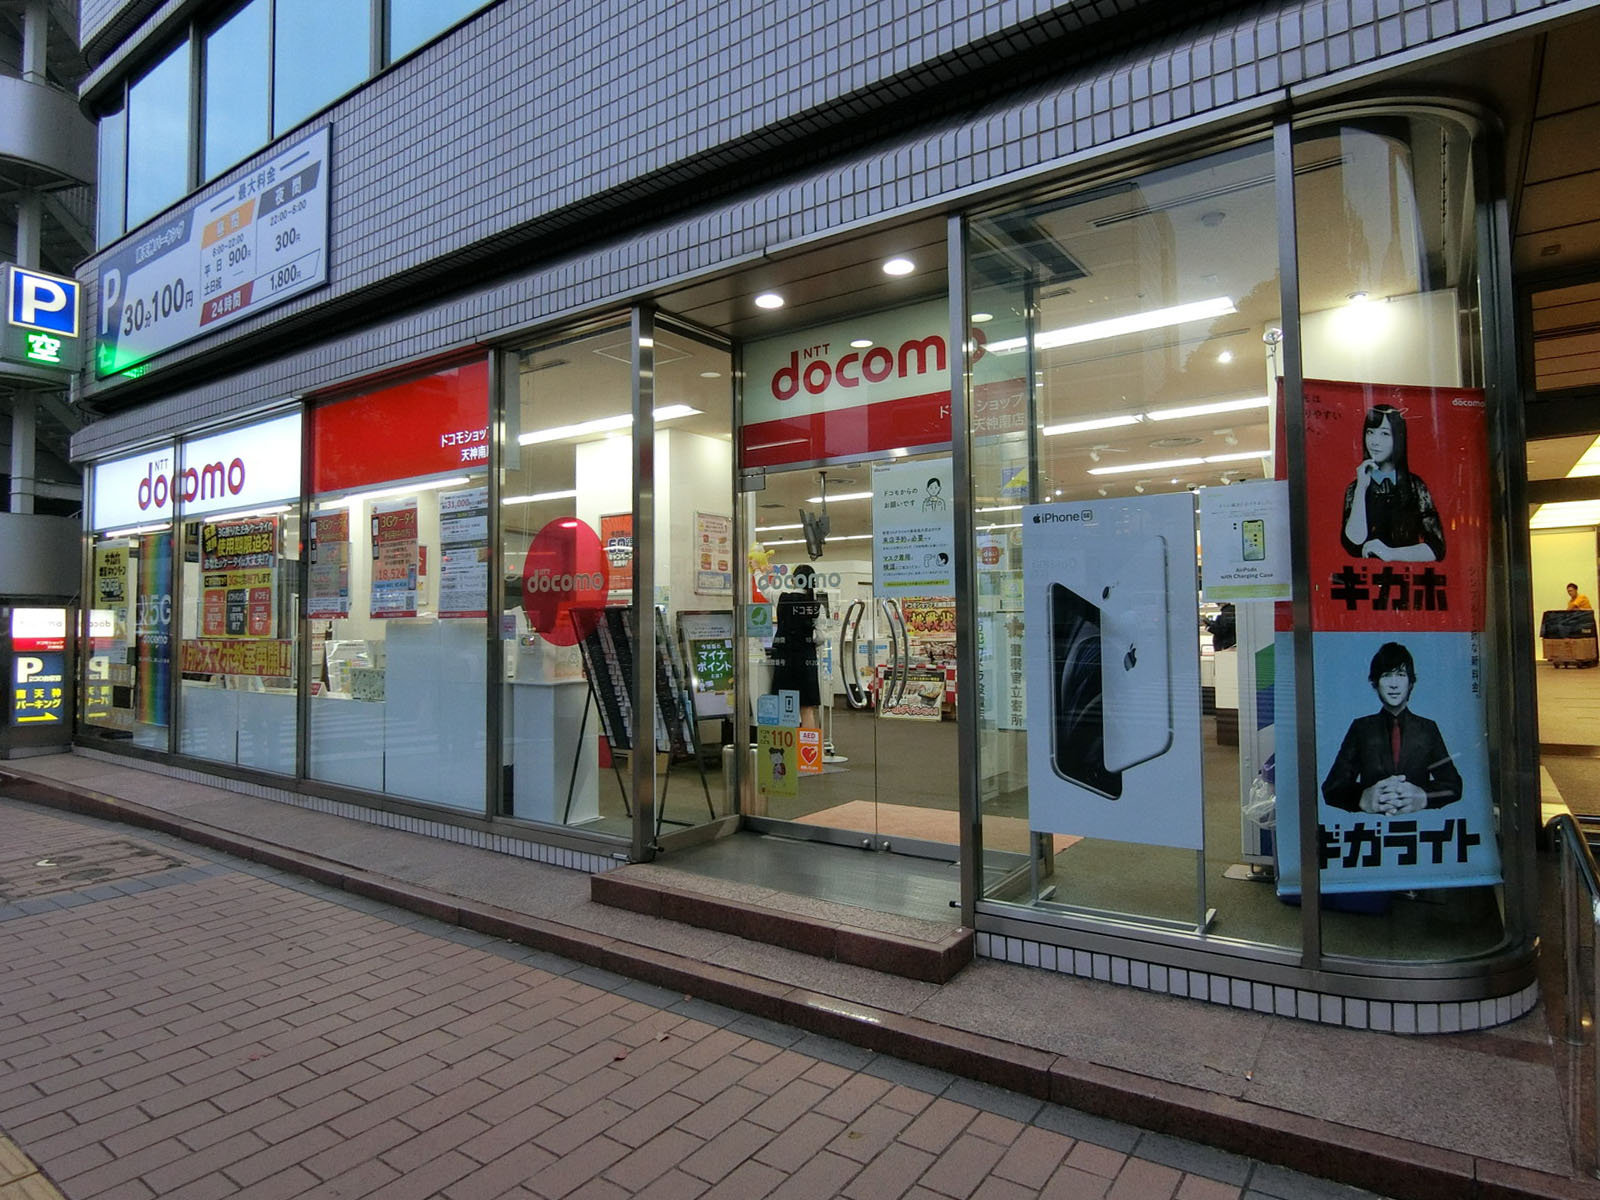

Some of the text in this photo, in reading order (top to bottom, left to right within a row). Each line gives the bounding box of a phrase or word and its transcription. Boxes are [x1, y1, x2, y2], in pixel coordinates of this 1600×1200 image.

[21, 274, 67, 324] P
[101, 268, 122, 335] P
[802, 343, 830, 359] NTT
[441, 426, 489, 448] ドコモショッ
[154, 458, 169, 470] NTT
[884, 488, 919, 498] ドコモからの
[1041, 512, 1080, 524] iPhone
[527, 569, 605, 593] docomo
[757, 570, 842, 591] docomo
[1331, 566, 1449, 611] ギガホ
[698, 650, 727, 661] マイナ
[17, 657, 44, 684] P
[697, 661, 733, 673] ポイント
[16, 699, 62, 710] パーキング
[771, 729, 794, 748] 110
[1319, 818, 1481, 870] ギガライト
